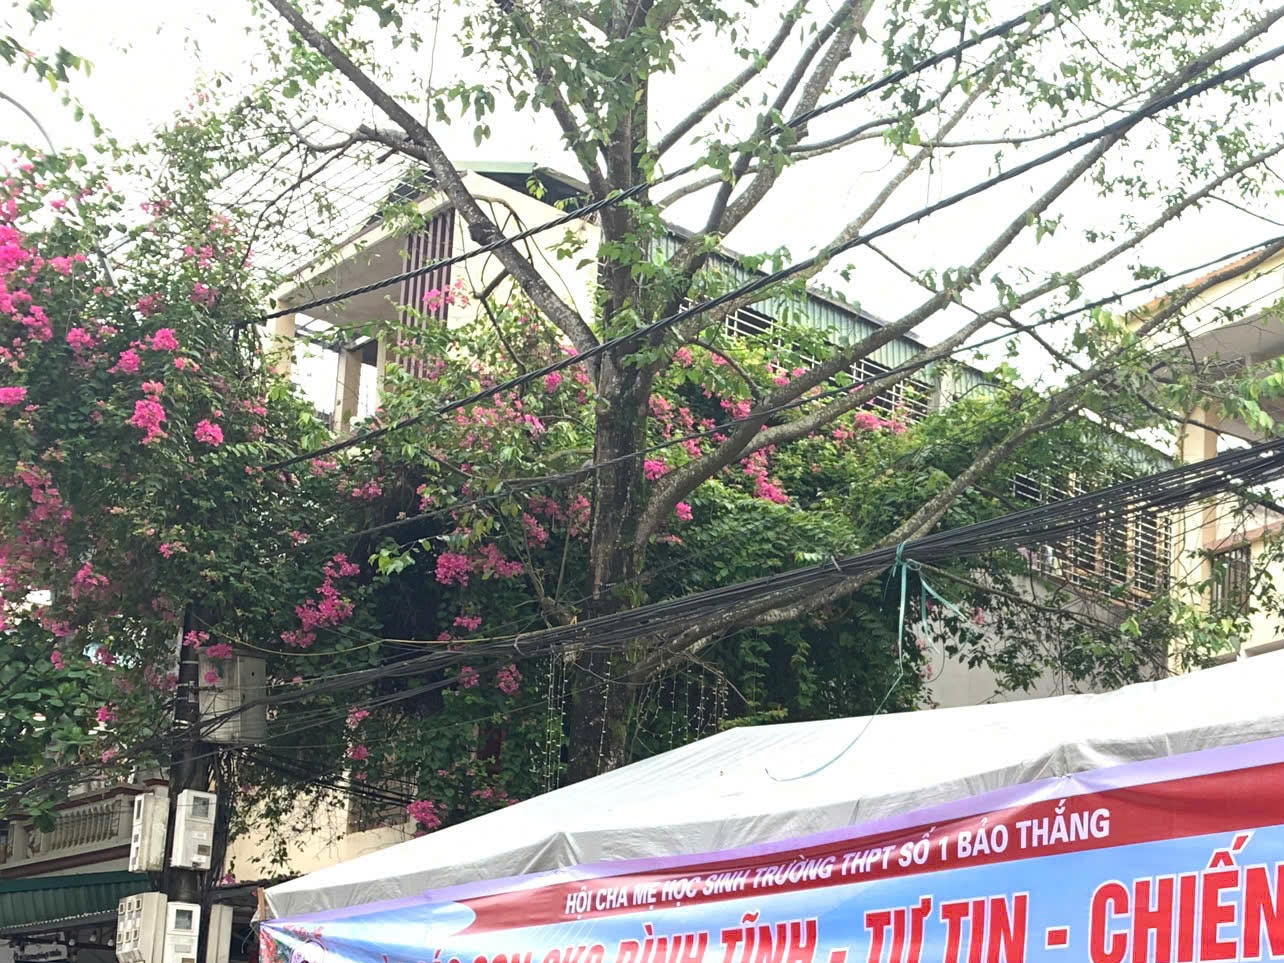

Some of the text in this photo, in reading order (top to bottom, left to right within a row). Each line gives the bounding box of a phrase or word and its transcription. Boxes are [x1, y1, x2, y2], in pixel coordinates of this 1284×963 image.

[565, 799, 1111, 918] HỘI CHA MẸ HỌC SINH TRƯỜNG THPT SỐ 1 BẢO THẮNG
